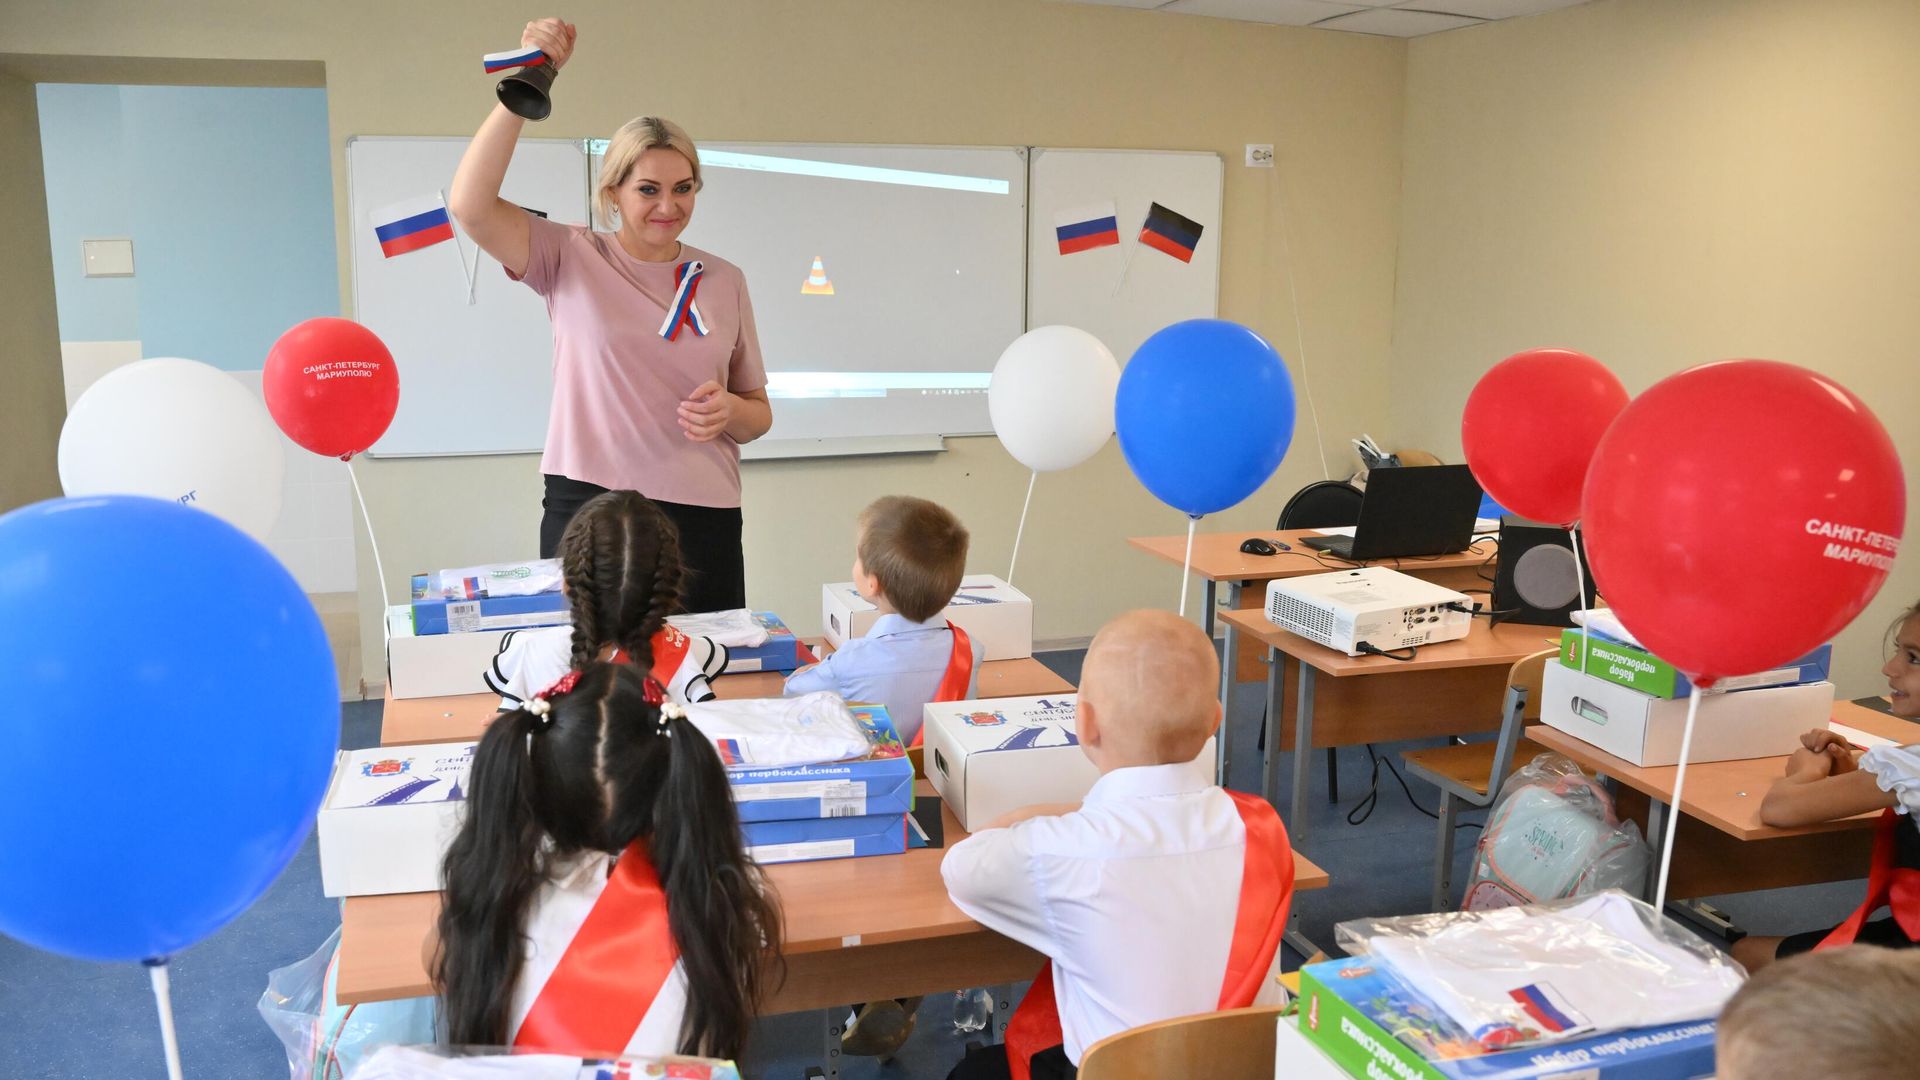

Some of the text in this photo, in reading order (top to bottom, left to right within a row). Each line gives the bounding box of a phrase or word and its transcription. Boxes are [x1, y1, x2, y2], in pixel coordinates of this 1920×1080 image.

[303, 361, 381, 374] САНКТ-ПЕТЕРБУРГ
[316, 369, 373, 380] МАРИУПОЛЮ
[1591, 647, 1656, 673] первоклассника
[1609, 664, 1635, 682] Набор
[749, 766, 851, 779] первоклассника
